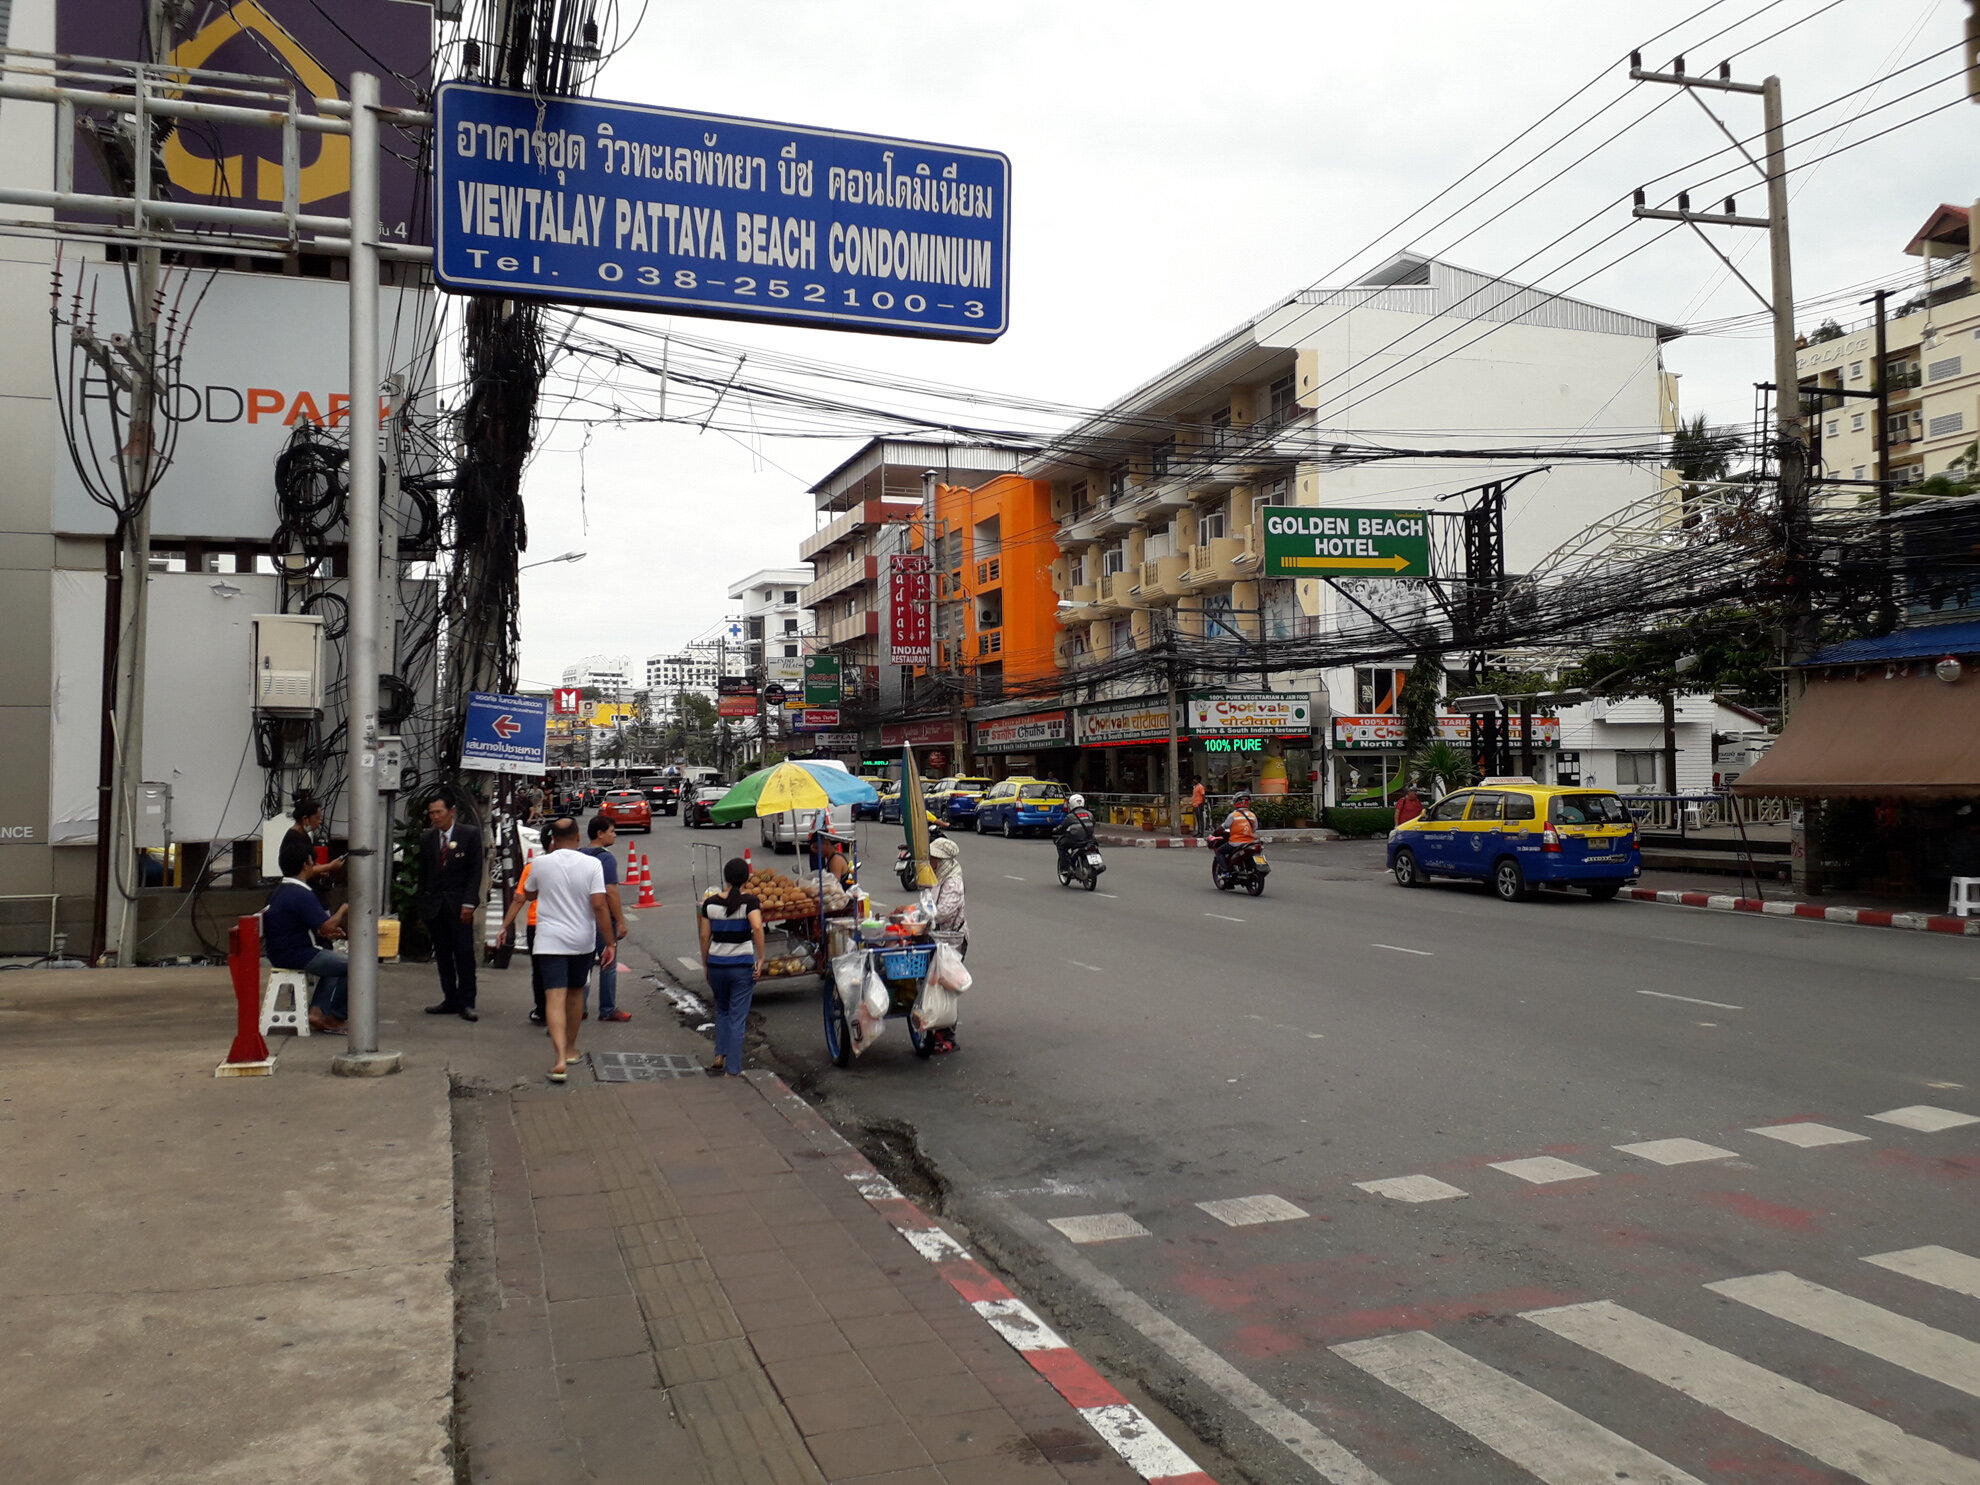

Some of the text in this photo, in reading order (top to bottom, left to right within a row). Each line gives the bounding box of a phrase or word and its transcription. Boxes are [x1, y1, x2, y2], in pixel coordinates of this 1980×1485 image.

[597, 123, 767, 192] วิวทะเลพัทยา
[778, 142, 813, 198] บีช
[829, 152, 993, 219] คอนโดมิเนียม
[394, 221, 407, 239] 4
[457, 180, 993, 289] VIEWTALAY PATTAYA BEACH CONDOMINIUM
[466, 248, 560, 277] Tel.
[1267, 516, 1423, 537] GOLDEN BEACH
[1315, 538, 1379, 557] HOTEL
[891, 655, 930, 664] RESTAURANT
[892, 646, 930, 655] INDIAN
[1112, 702, 1141, 712] VEGETARIAN
[1088, 734, 1103, 742] North
[1108, 732, 1123, 740] South
[1124, 731, 1140, 739] Indian
[1141, 729, 1170, 737] Restauran
[1205, 739, 1262, 752] 100% PURE
